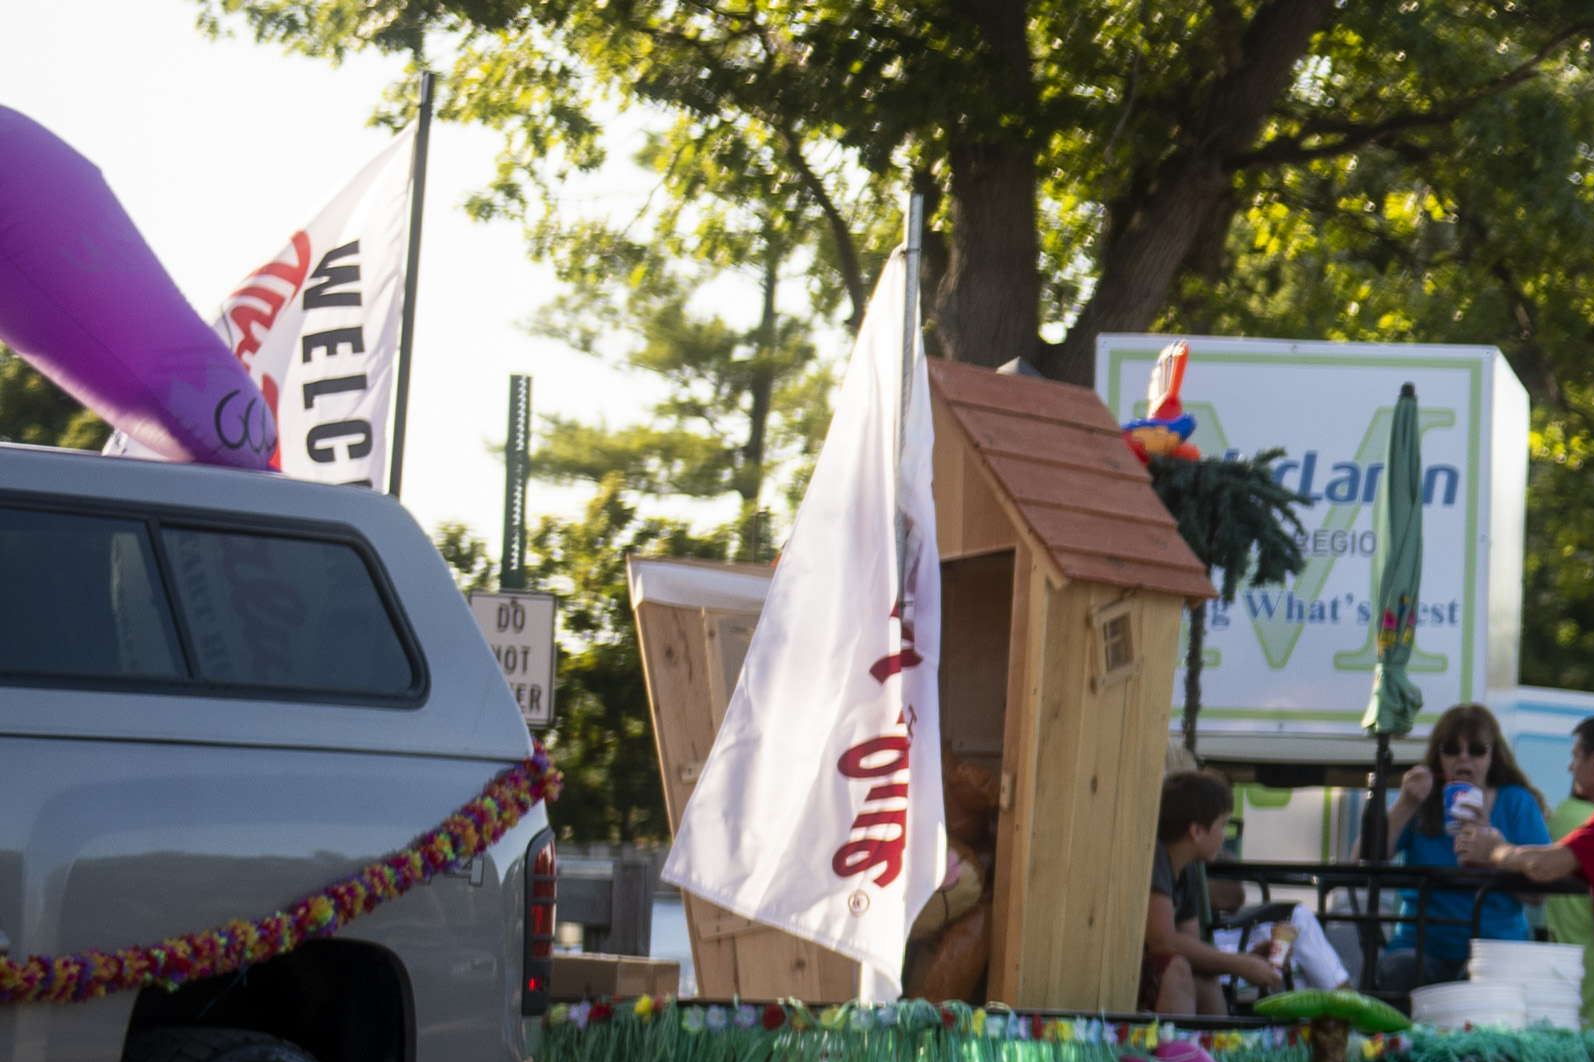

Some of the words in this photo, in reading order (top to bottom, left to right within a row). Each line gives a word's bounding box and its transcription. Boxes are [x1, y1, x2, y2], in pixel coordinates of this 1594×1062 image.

[303, 239, 373, 489] WELC
[1224, 448, 1461, 505] cLarn
[496, 603, 526, 633] DO
[1244, 589, 1373, 624] What's
[1416, 598, 1460, 627] est
